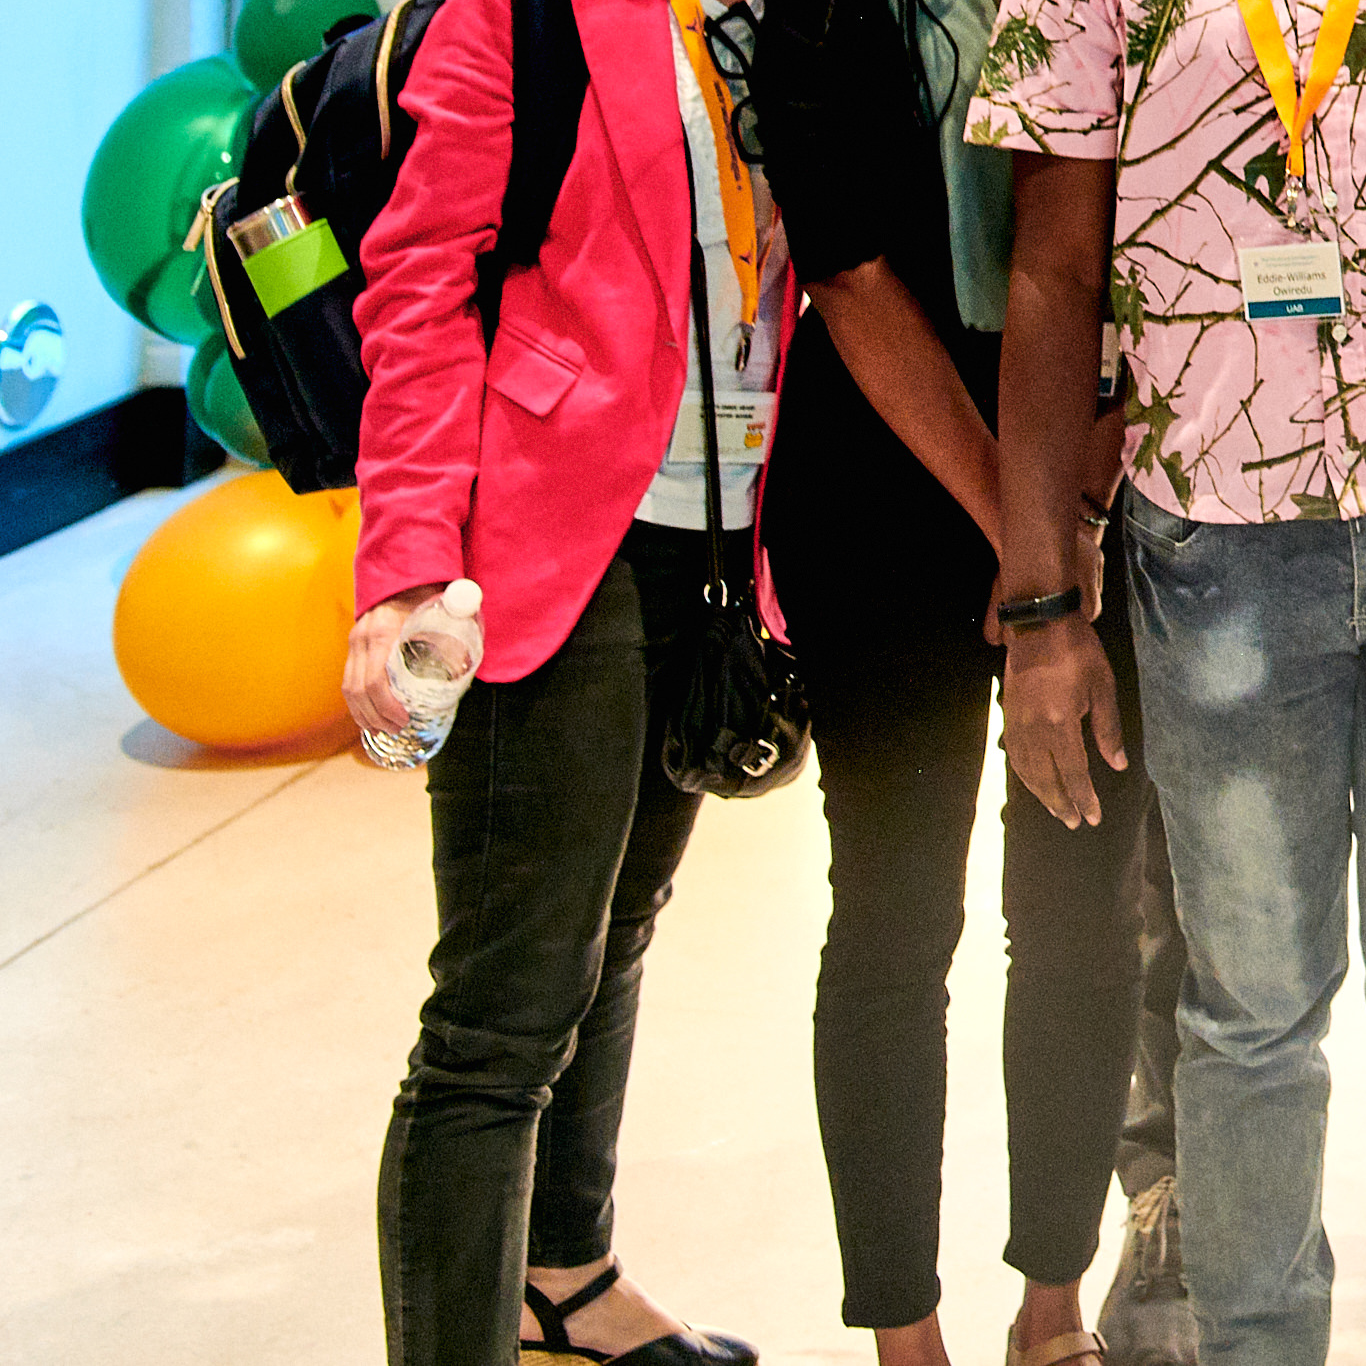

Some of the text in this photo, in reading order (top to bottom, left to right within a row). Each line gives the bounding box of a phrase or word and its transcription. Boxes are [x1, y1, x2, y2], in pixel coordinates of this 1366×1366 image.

[1257, 272, 1327, 285] Eddie-Williams
[1273, 285, 1313, 296] Owiredu
[1286, 304, 1304, 313] UAB
